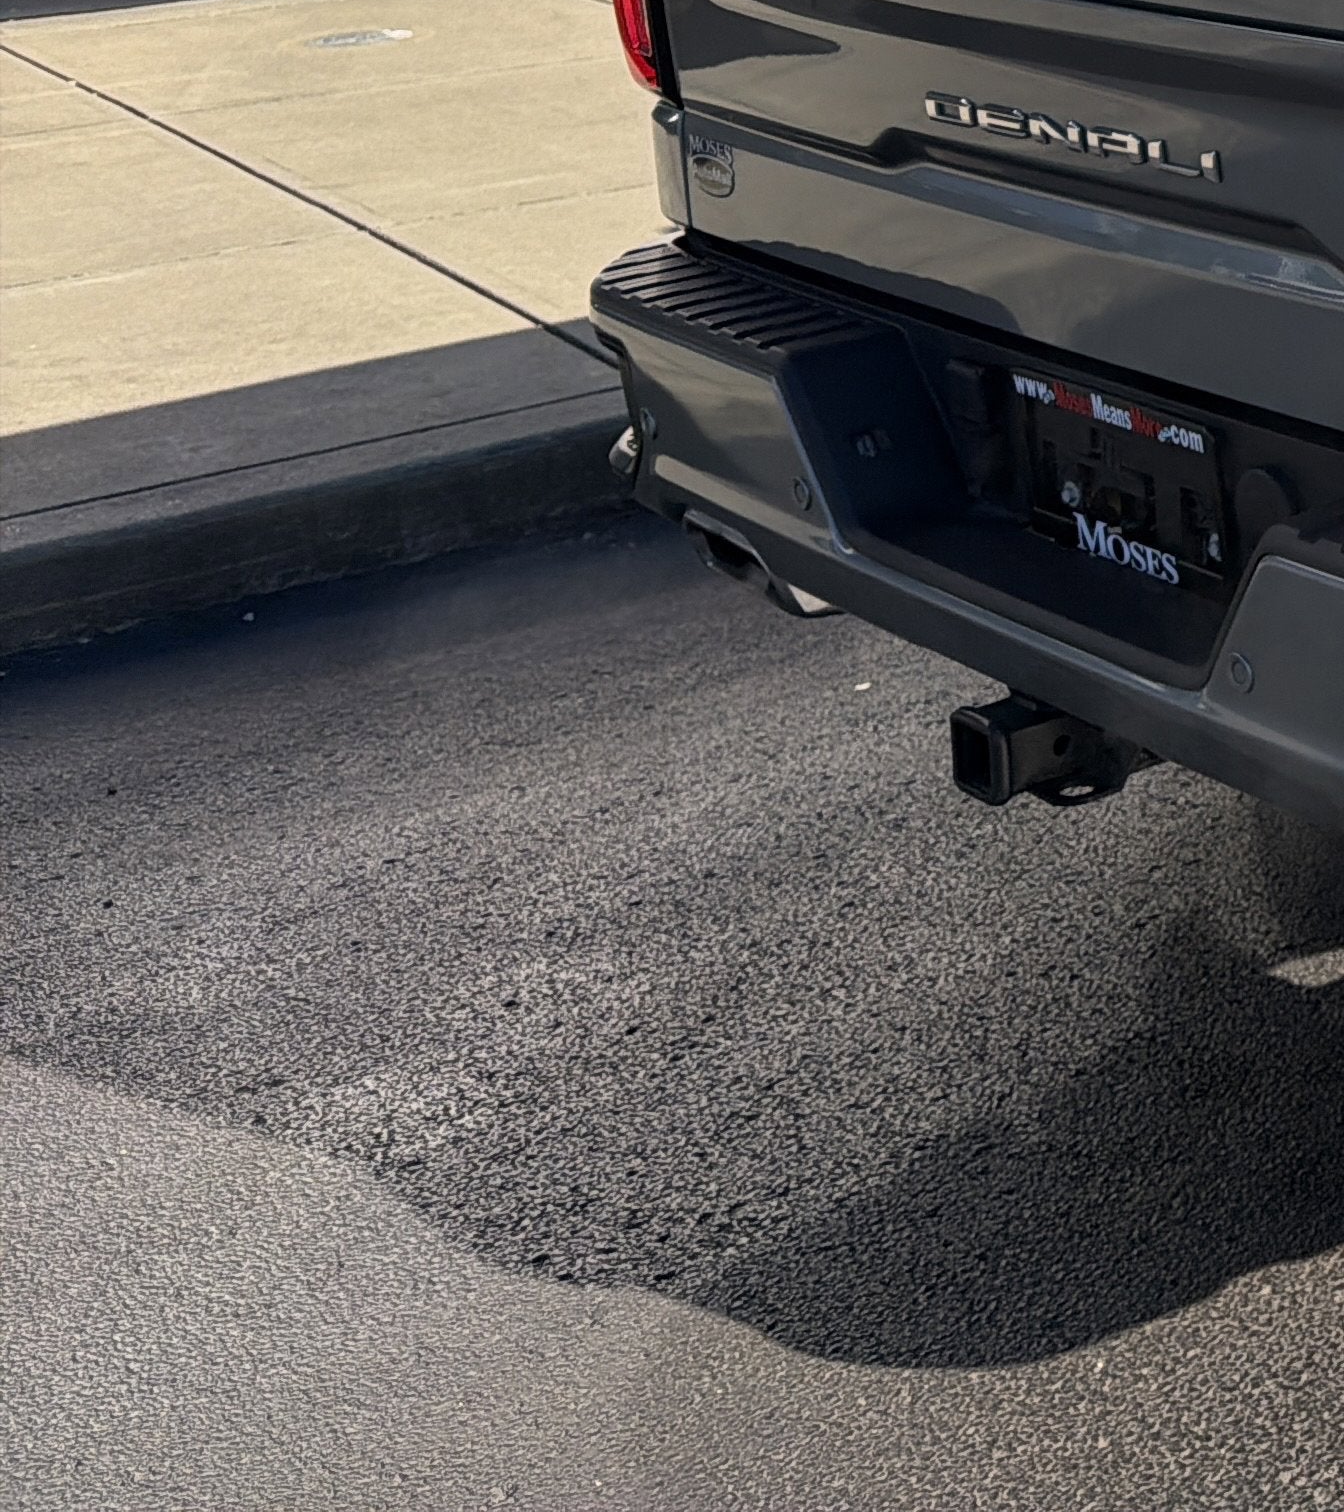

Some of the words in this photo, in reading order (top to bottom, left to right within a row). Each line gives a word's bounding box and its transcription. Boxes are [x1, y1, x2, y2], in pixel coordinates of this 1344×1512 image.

[688, 135, 734, 164] MOSES
[924, 90, 1223, 183] DENALI
[1073, 511, 1179, 585] MOSES
